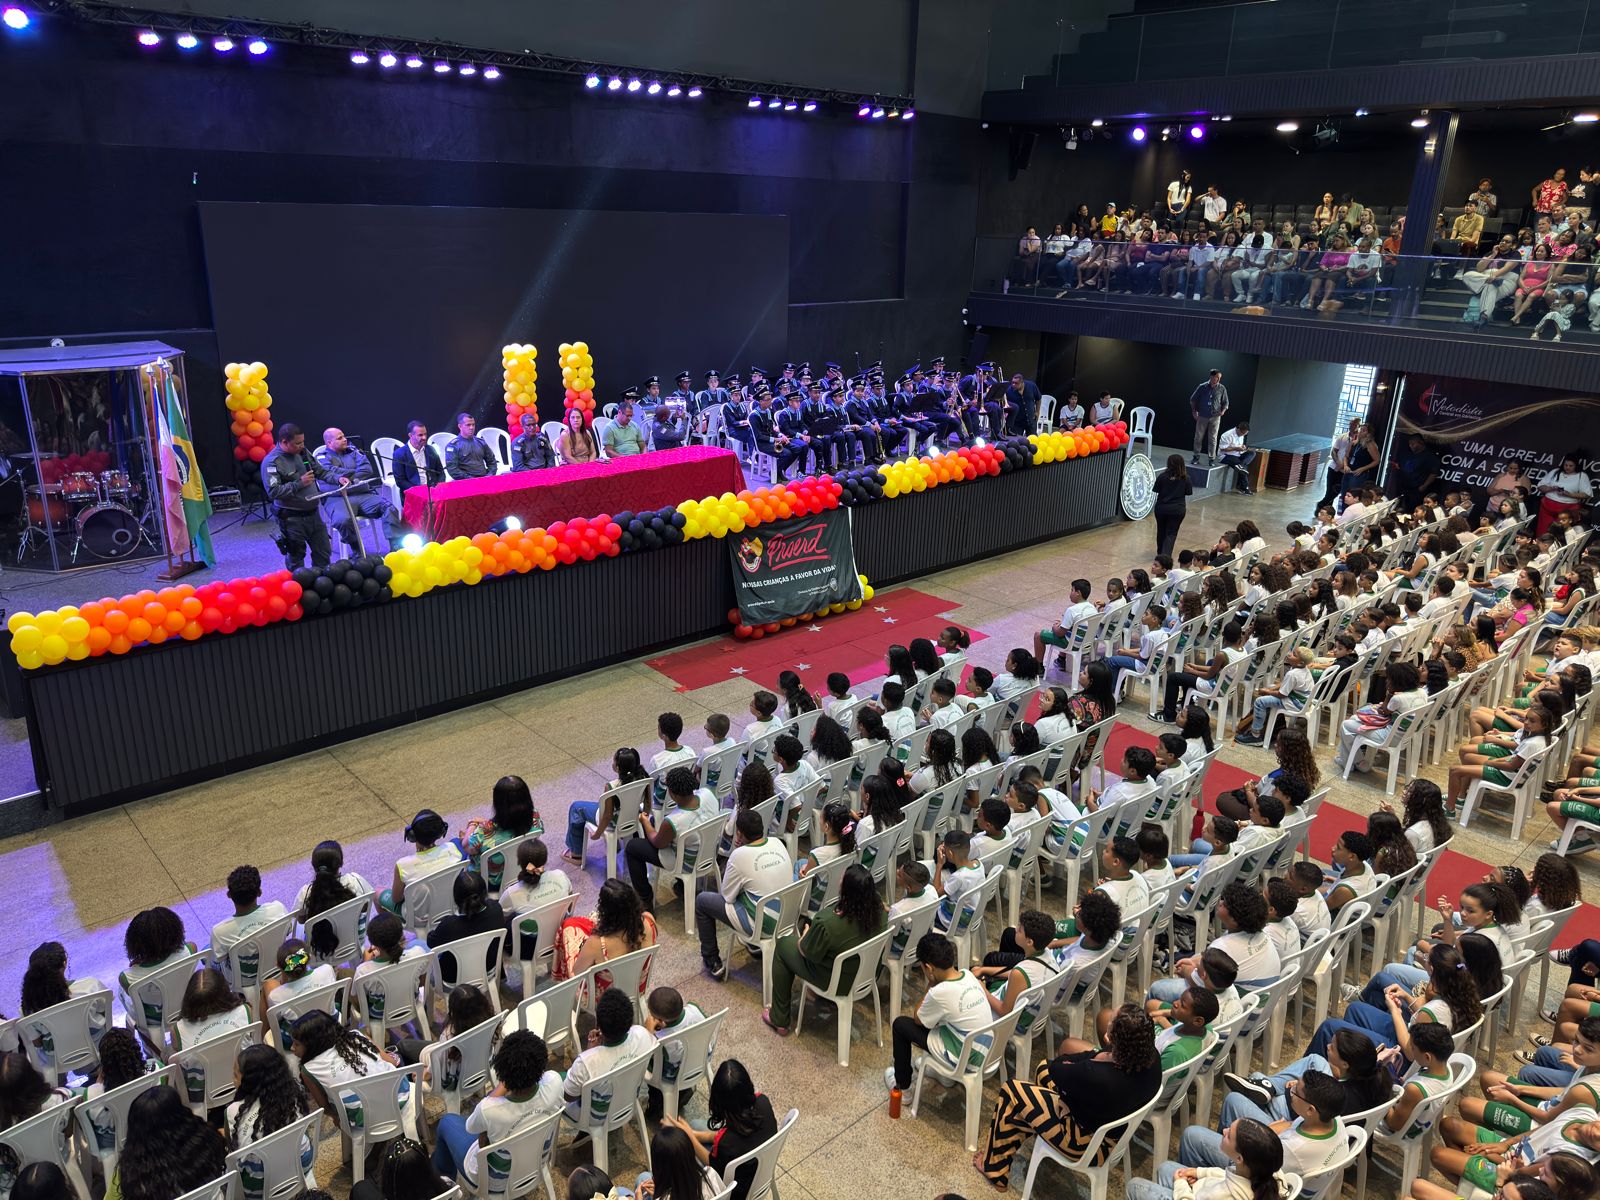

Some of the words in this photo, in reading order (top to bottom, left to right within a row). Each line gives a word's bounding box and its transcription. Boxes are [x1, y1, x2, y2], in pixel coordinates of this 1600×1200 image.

[1432, 397, 1484, 416] Metodista
[1441, 454, 1475, 469] COM
[1475, 459, 1487, 471] A
[1498, 446, 1554, 465] IGREJA
[767, 524, 828, 567] Proerd
[741, 580, 763, 589] NOSSAS
[763, 575, 790, 586] CRIANÇAS
[790, 573, 796, 582] A
[795, 570, 813, 580] FAVOR
[813, 568, 822, 576] DA
[198, 1020, 222, 1037] MUNICIPAL
[1323, 1141, 1344, 1167] MUNICIPAL
